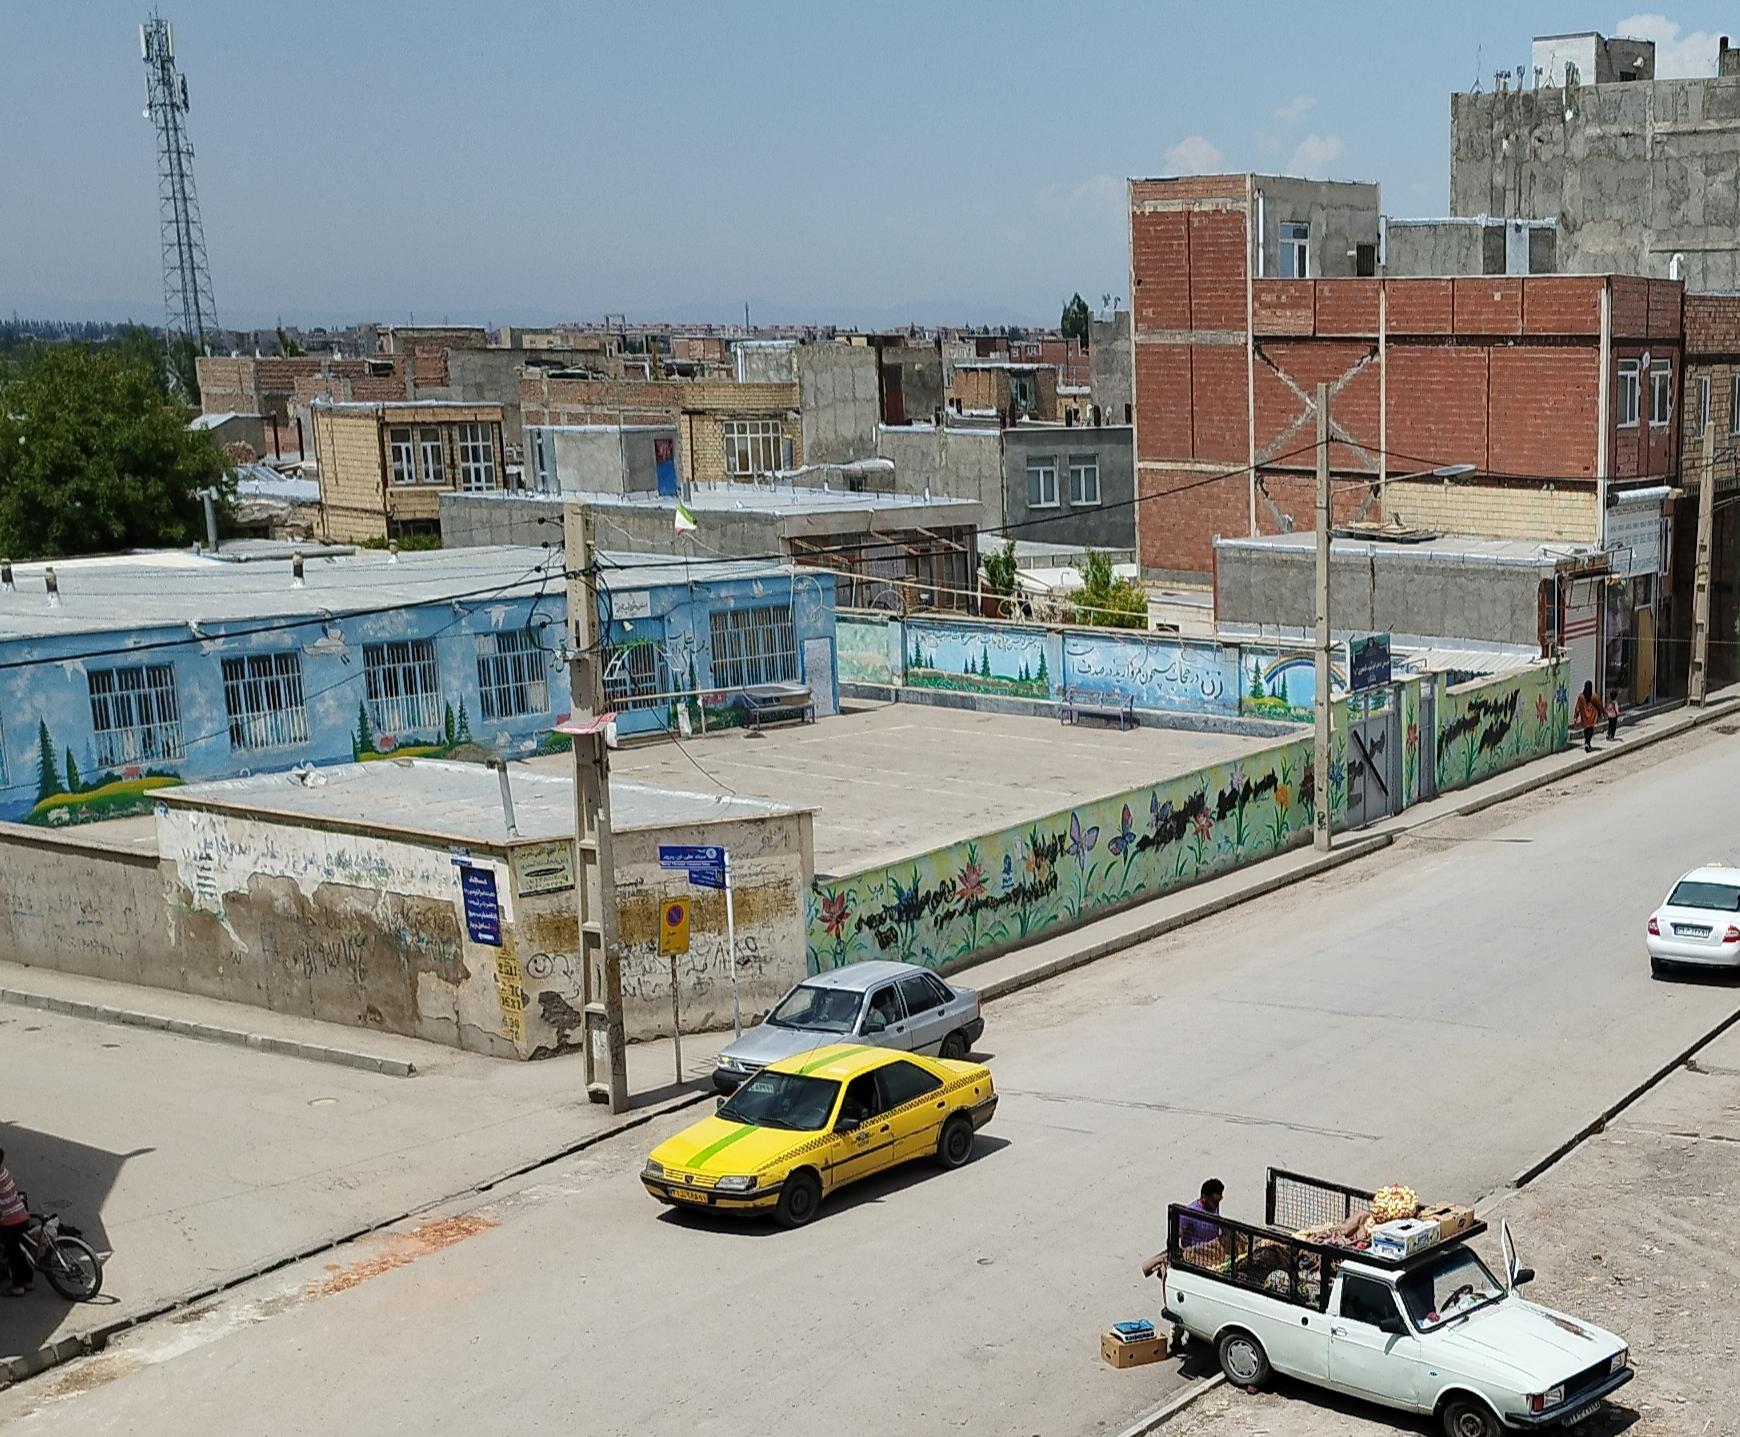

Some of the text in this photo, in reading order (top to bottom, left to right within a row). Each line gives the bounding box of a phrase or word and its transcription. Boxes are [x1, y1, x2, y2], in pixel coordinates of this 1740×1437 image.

[1077, 659, 1105, 677] صدف
[1165, 660, 1190, 692] حجاب
[1200, 671, 1223, 699] زن
